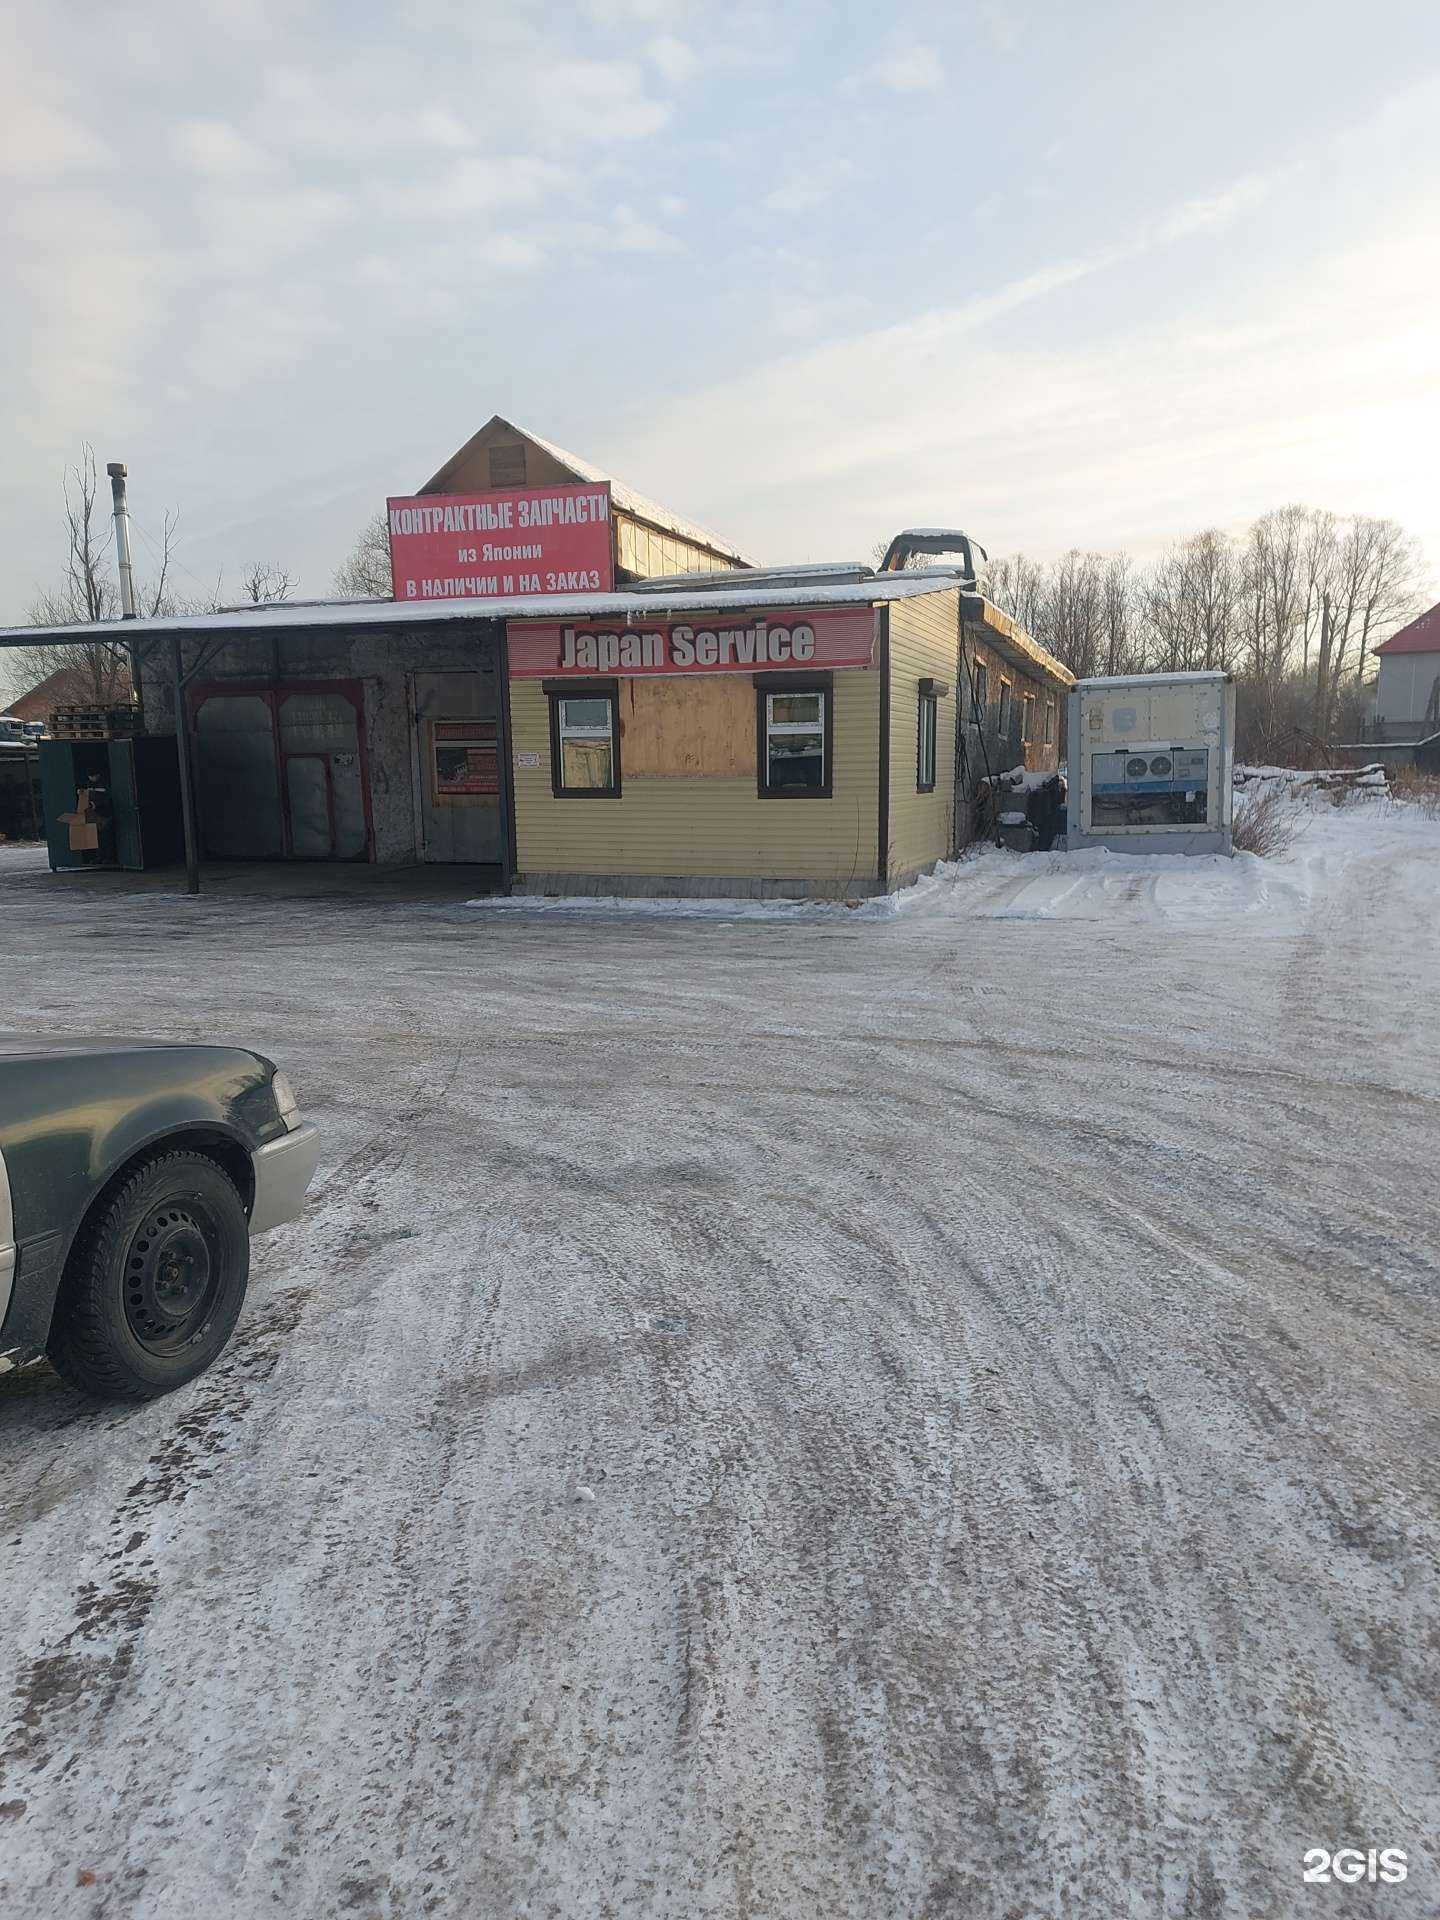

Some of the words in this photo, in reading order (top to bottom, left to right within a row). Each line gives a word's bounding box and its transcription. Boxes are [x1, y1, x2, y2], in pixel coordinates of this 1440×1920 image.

[390, 502, 513, 535] КОНТРАКТНЫЕ
[518, 495, 608, 527] ЗАПЧАСТИ
[458, 549, 477, 563] из
[482, 543, 542, 562] Японии
[406, 579, 416, 597] В
[422, 575, 497, 597] НАЛИЧИИ
[503, 575, 514, 593] И
[519, 573, 541, 592] НА
[546, 570, 600, 591] ЗАКАЗ
[560, 627, 664, 671] Japan
[672, 621, 816, 665] Service
